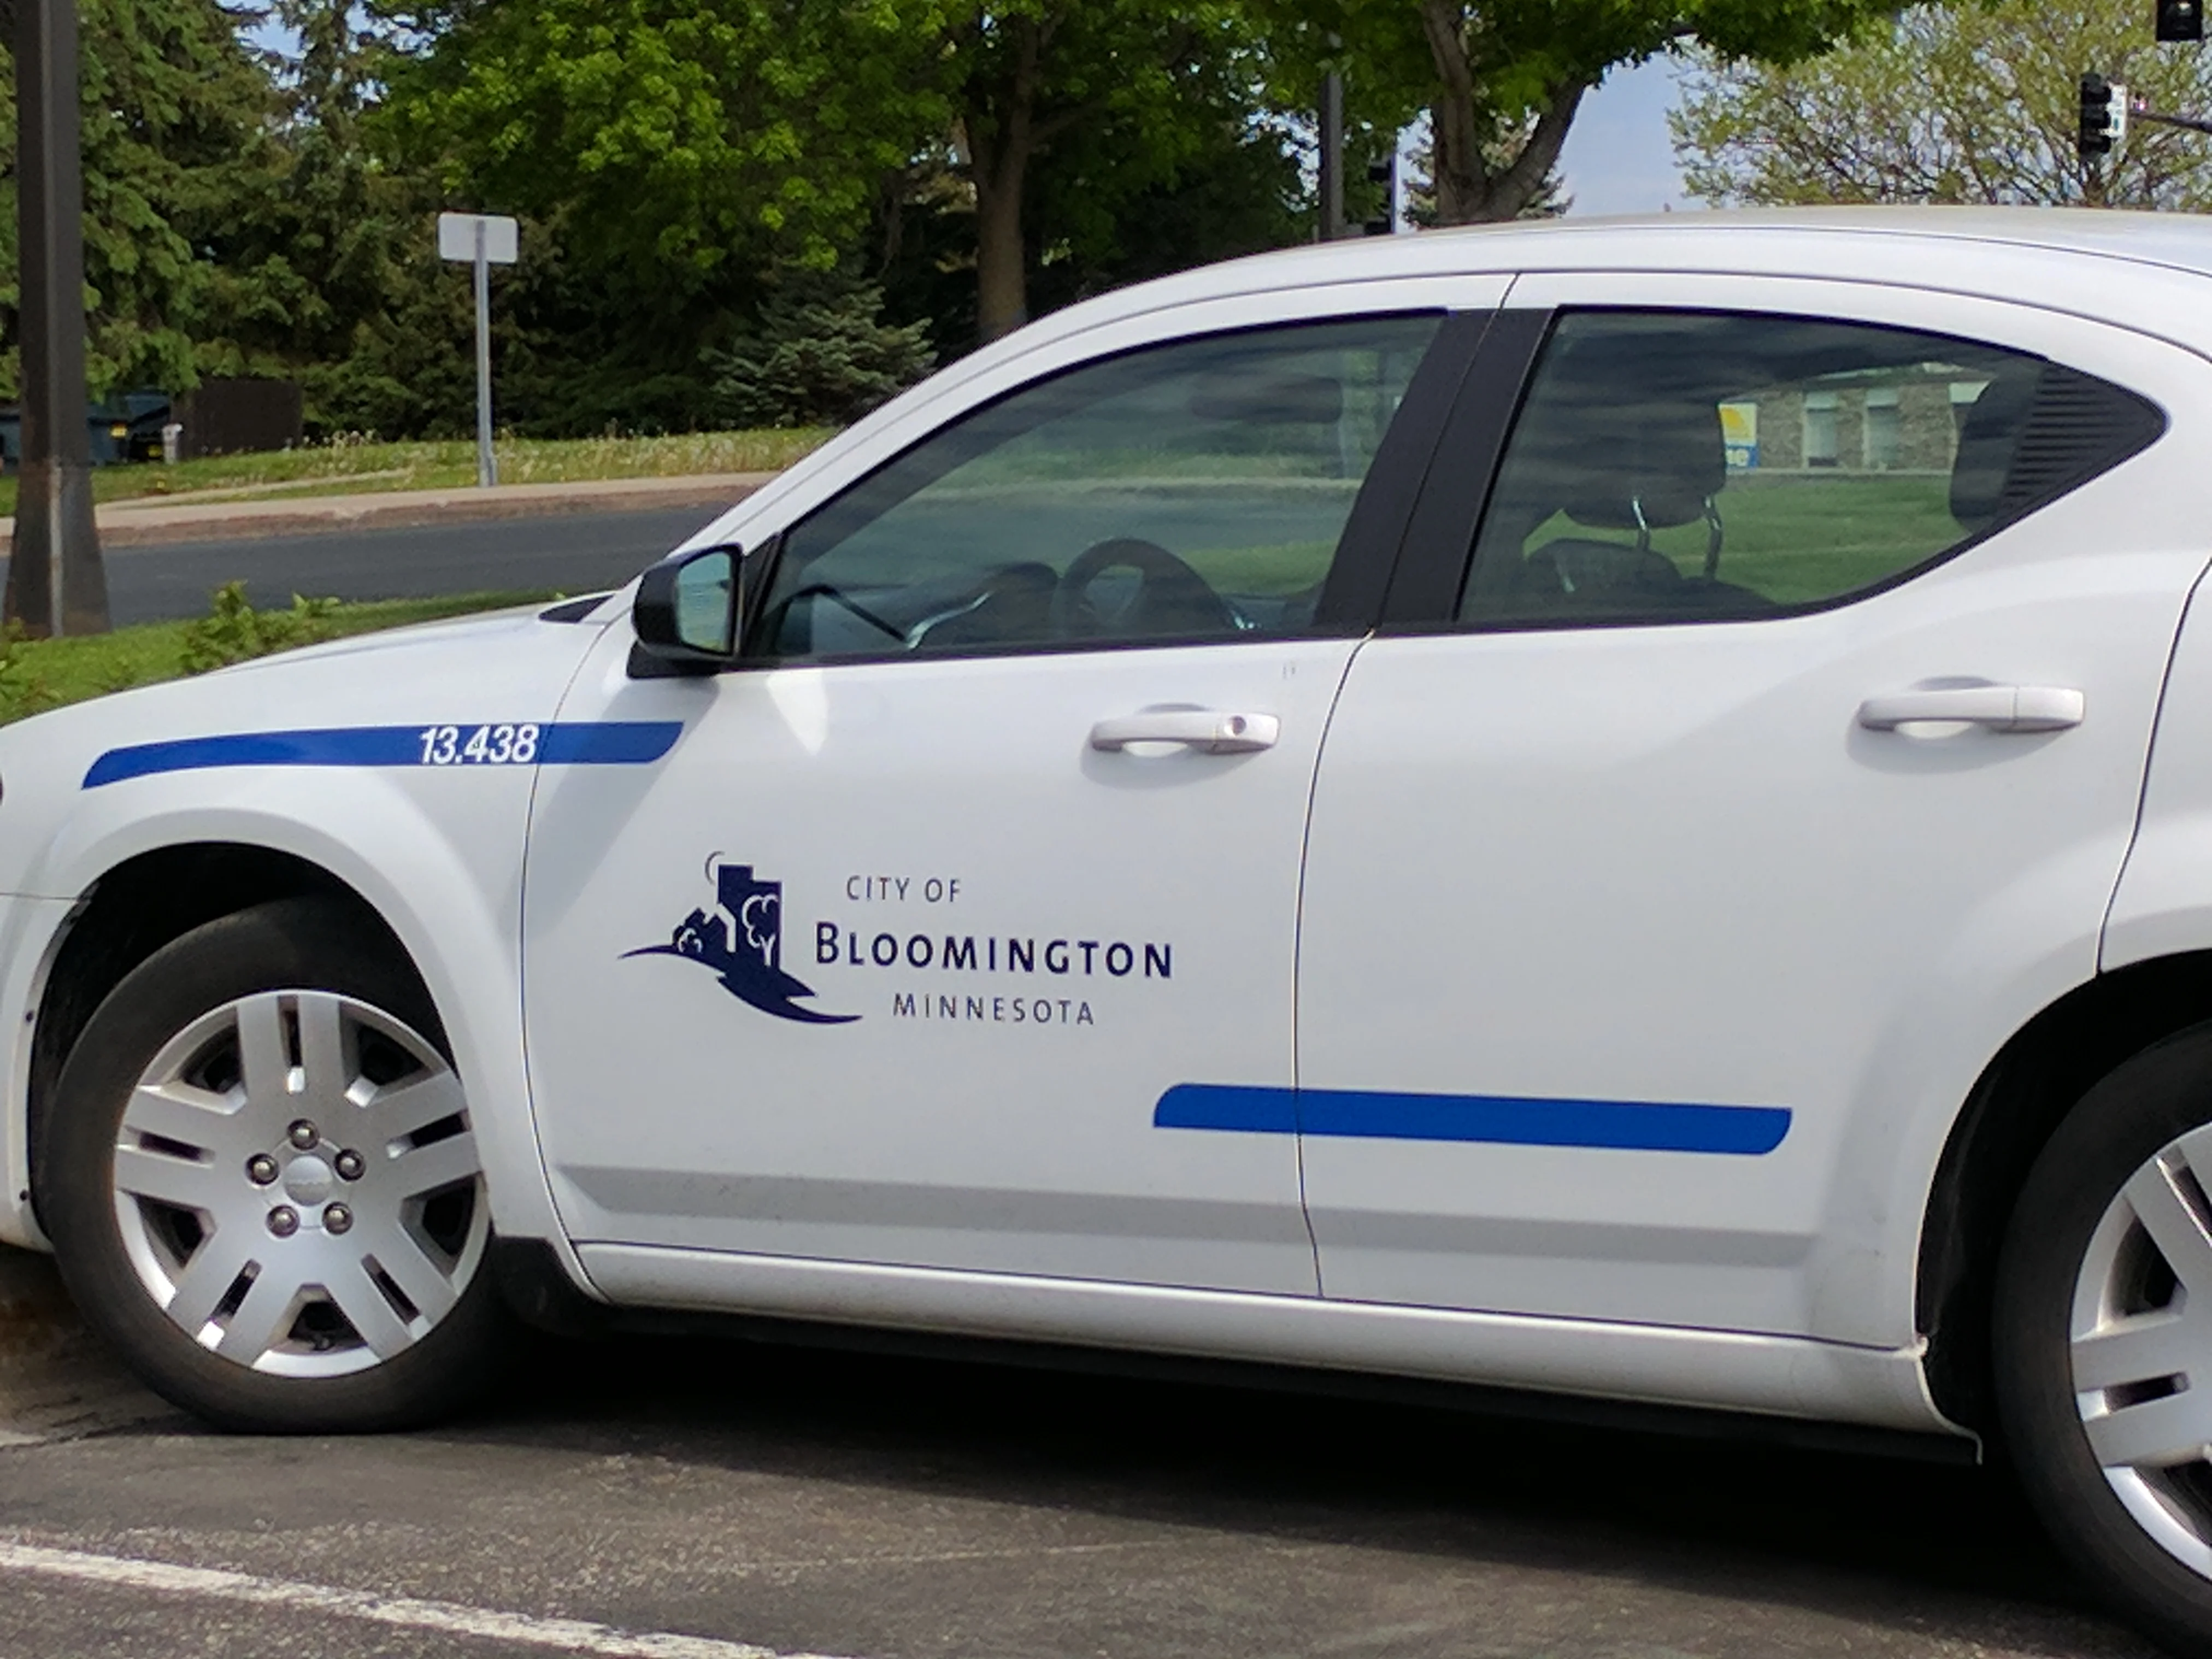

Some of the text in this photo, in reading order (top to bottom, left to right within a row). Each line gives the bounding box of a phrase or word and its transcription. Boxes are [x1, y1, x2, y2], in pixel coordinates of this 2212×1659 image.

[420, 724, 539, 764] 13.438
[845, 875, 962, 903] CITY OF
[816, 921, 1172, 979] BLOOMINGTON
[892, 992, 1095, 1026] MINNESOTA
